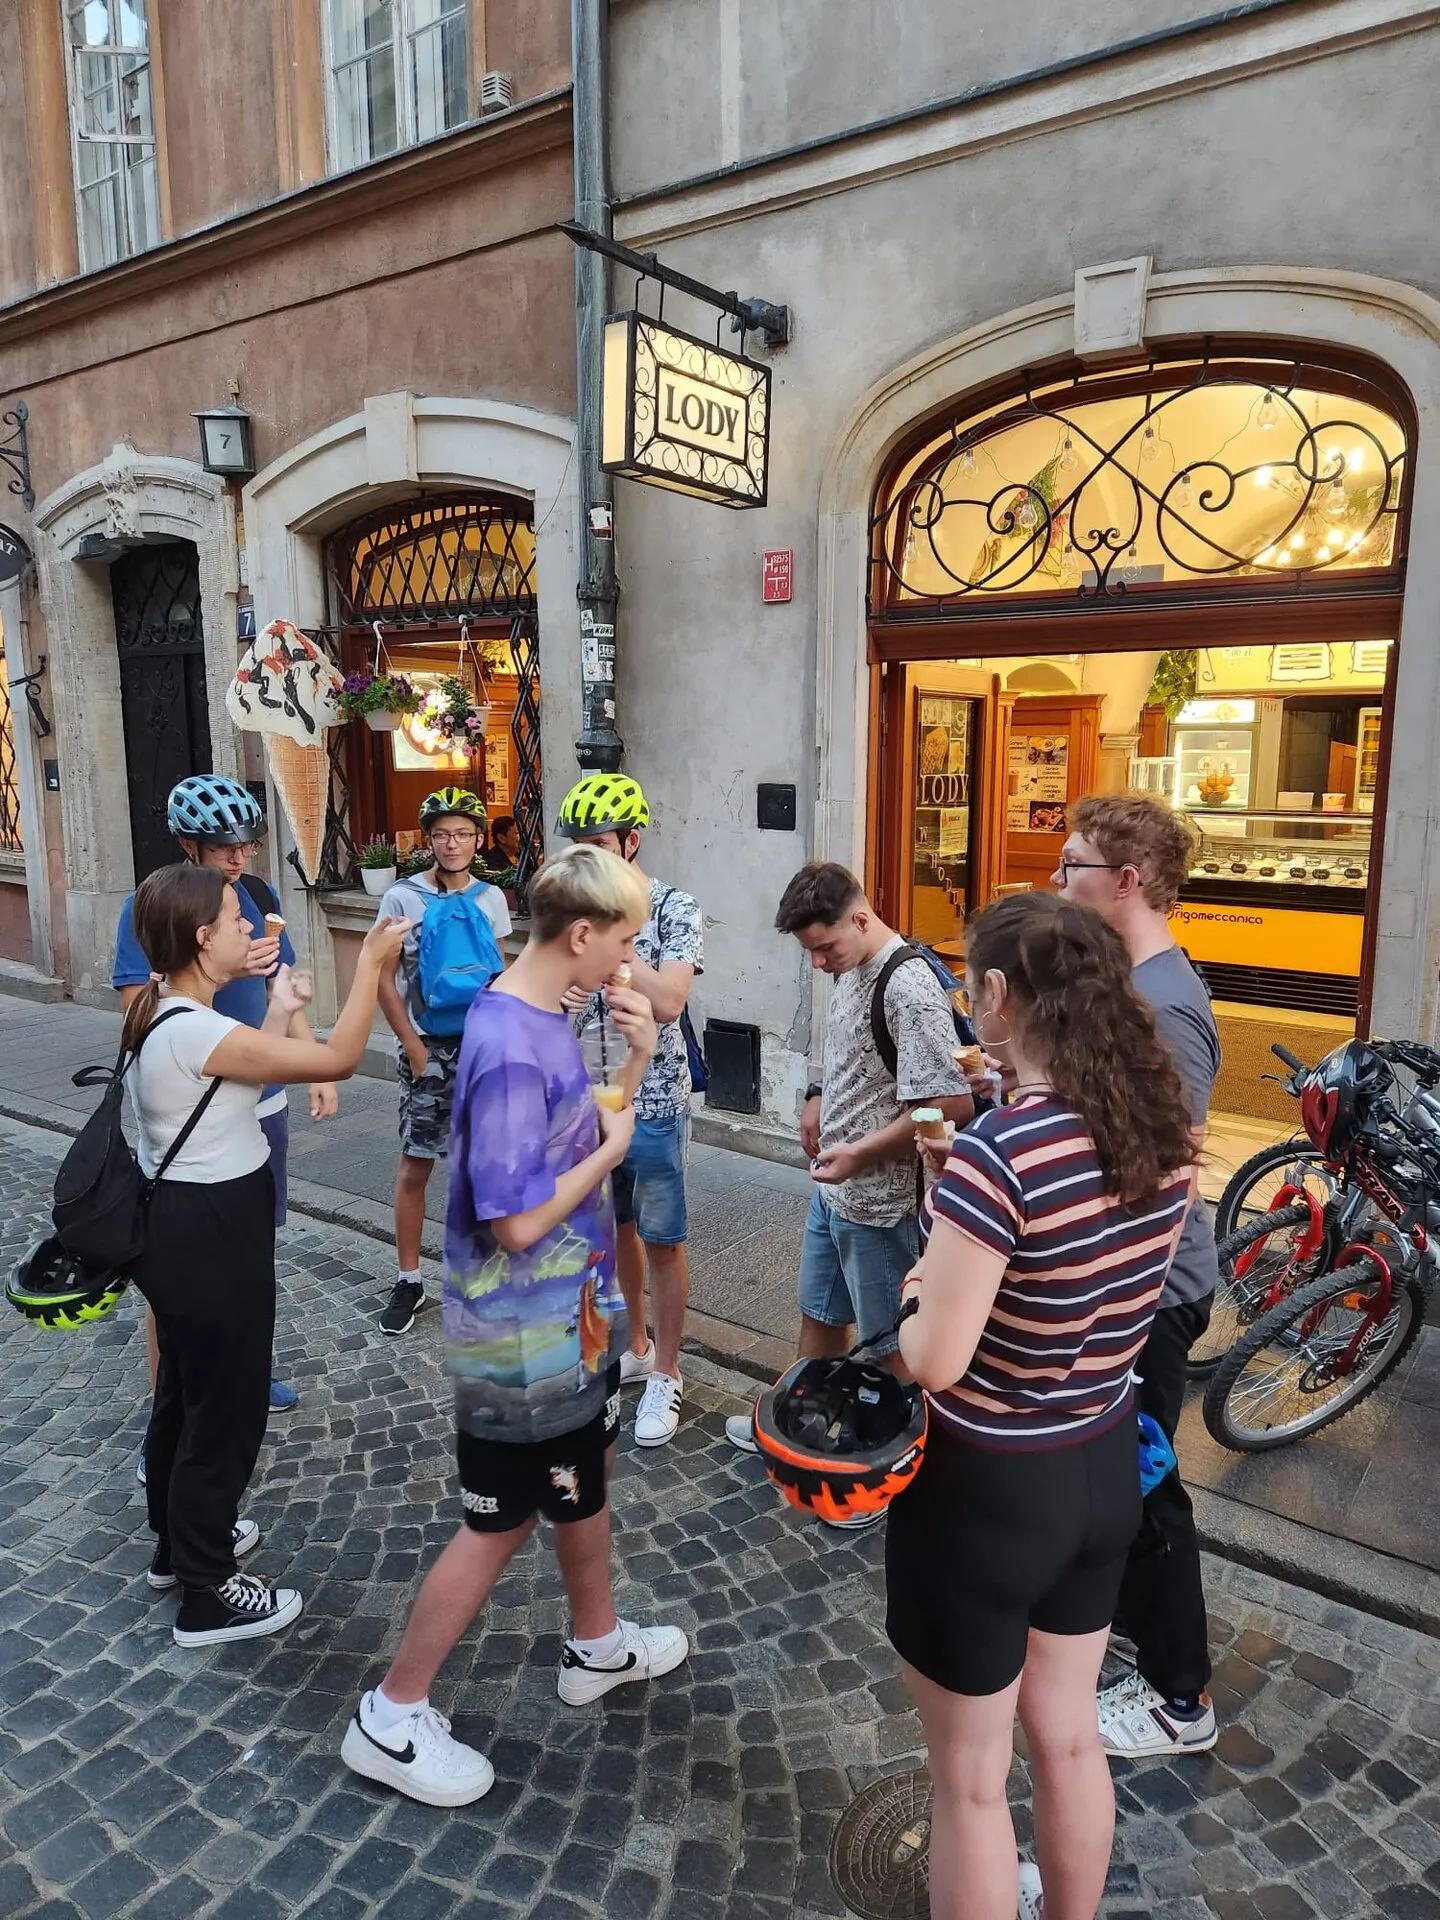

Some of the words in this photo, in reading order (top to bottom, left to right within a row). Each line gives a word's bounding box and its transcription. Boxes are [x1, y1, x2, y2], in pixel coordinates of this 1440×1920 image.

[665, 383, 740, 443] LODY
[219, 433, 232, 450] 7
[764, 557, 774, 572] H
[243, 612, 252, 635] 7
[920, 774, 969, 804] LODY
[1356, 1321, 1378, 1355] ZOOM
